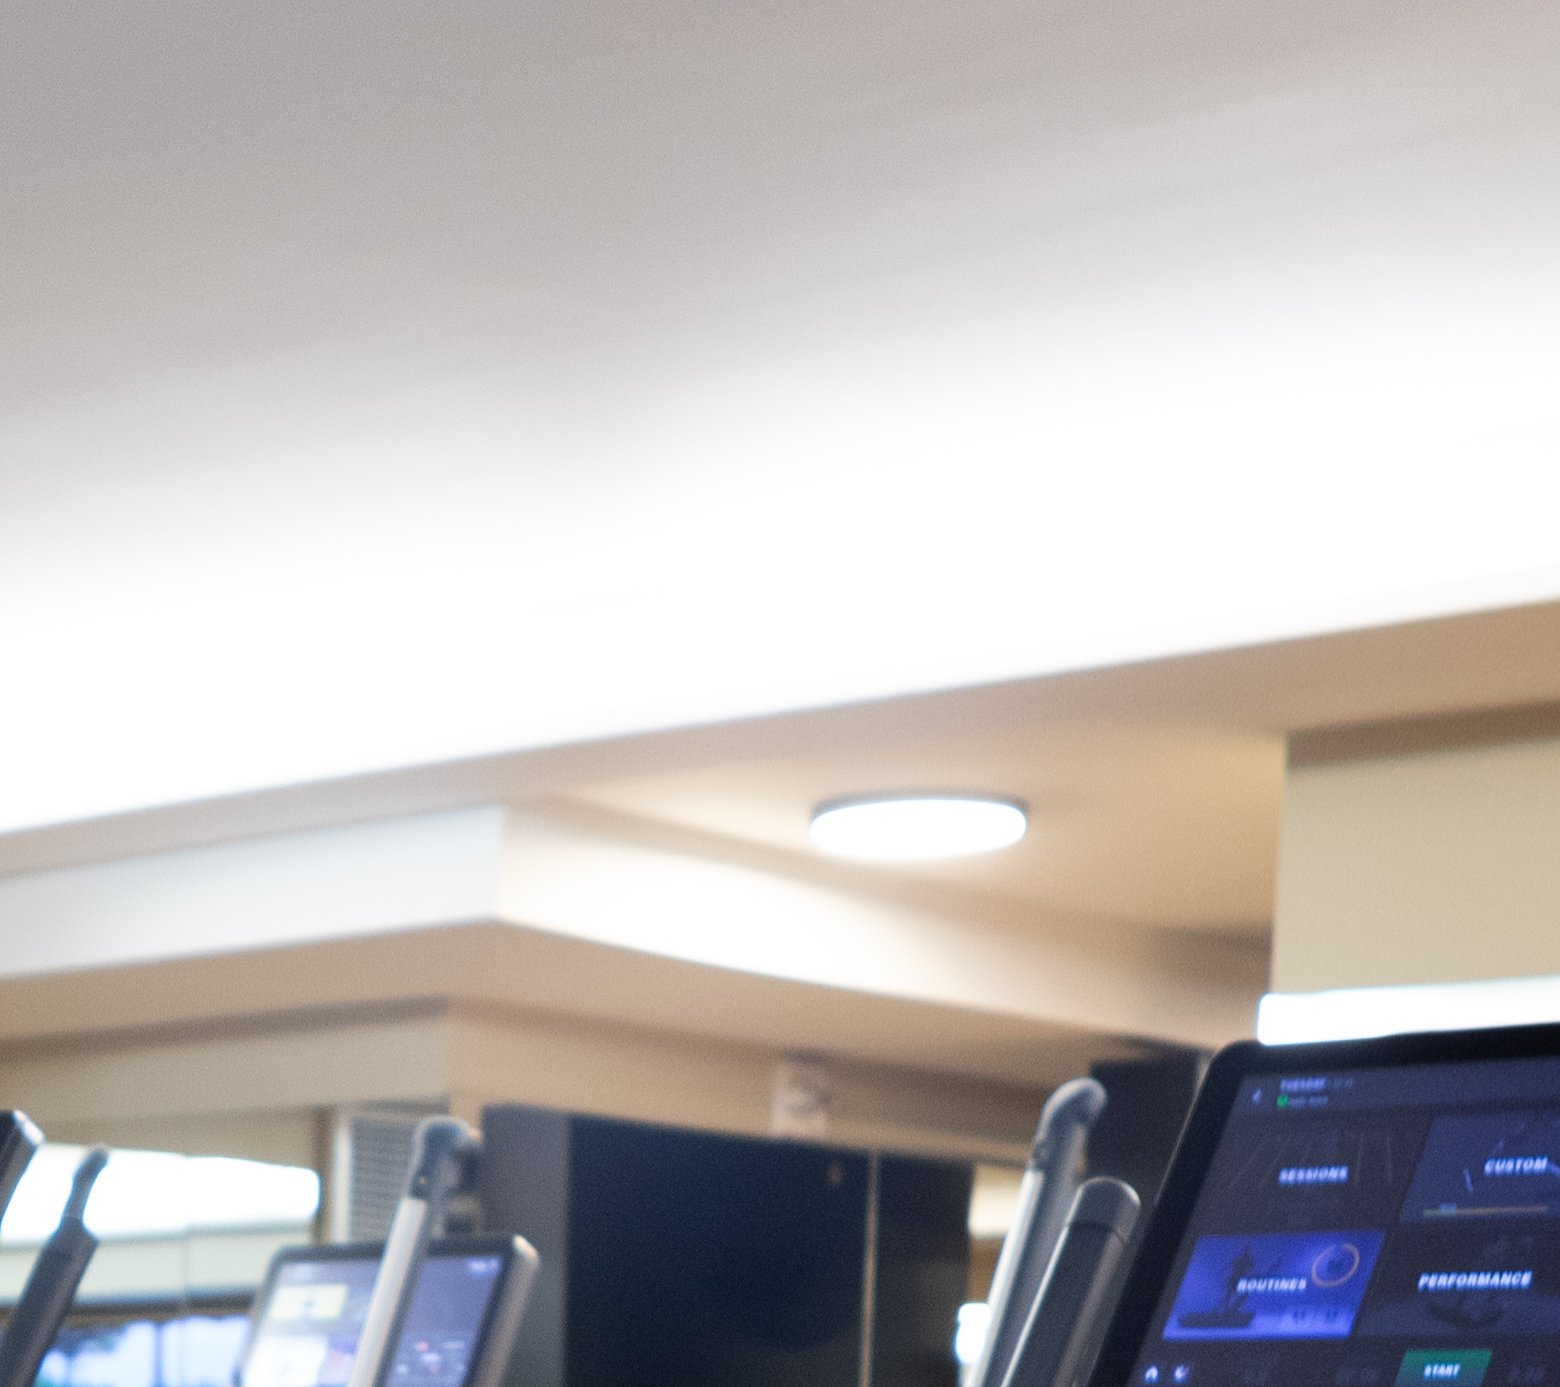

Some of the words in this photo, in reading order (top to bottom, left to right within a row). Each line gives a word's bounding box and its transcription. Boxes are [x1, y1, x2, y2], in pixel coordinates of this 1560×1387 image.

[1279, 1165, 1349, 1185] SESSIONS
[1484, 1156, 1548, 1177] CUSTOM
[1236, 1277, 1308, 1293] ROUTINES
[1418, 1270, 1533, 1291] PERFORMANCE
[1423, 1363, 1461, 1380] START
